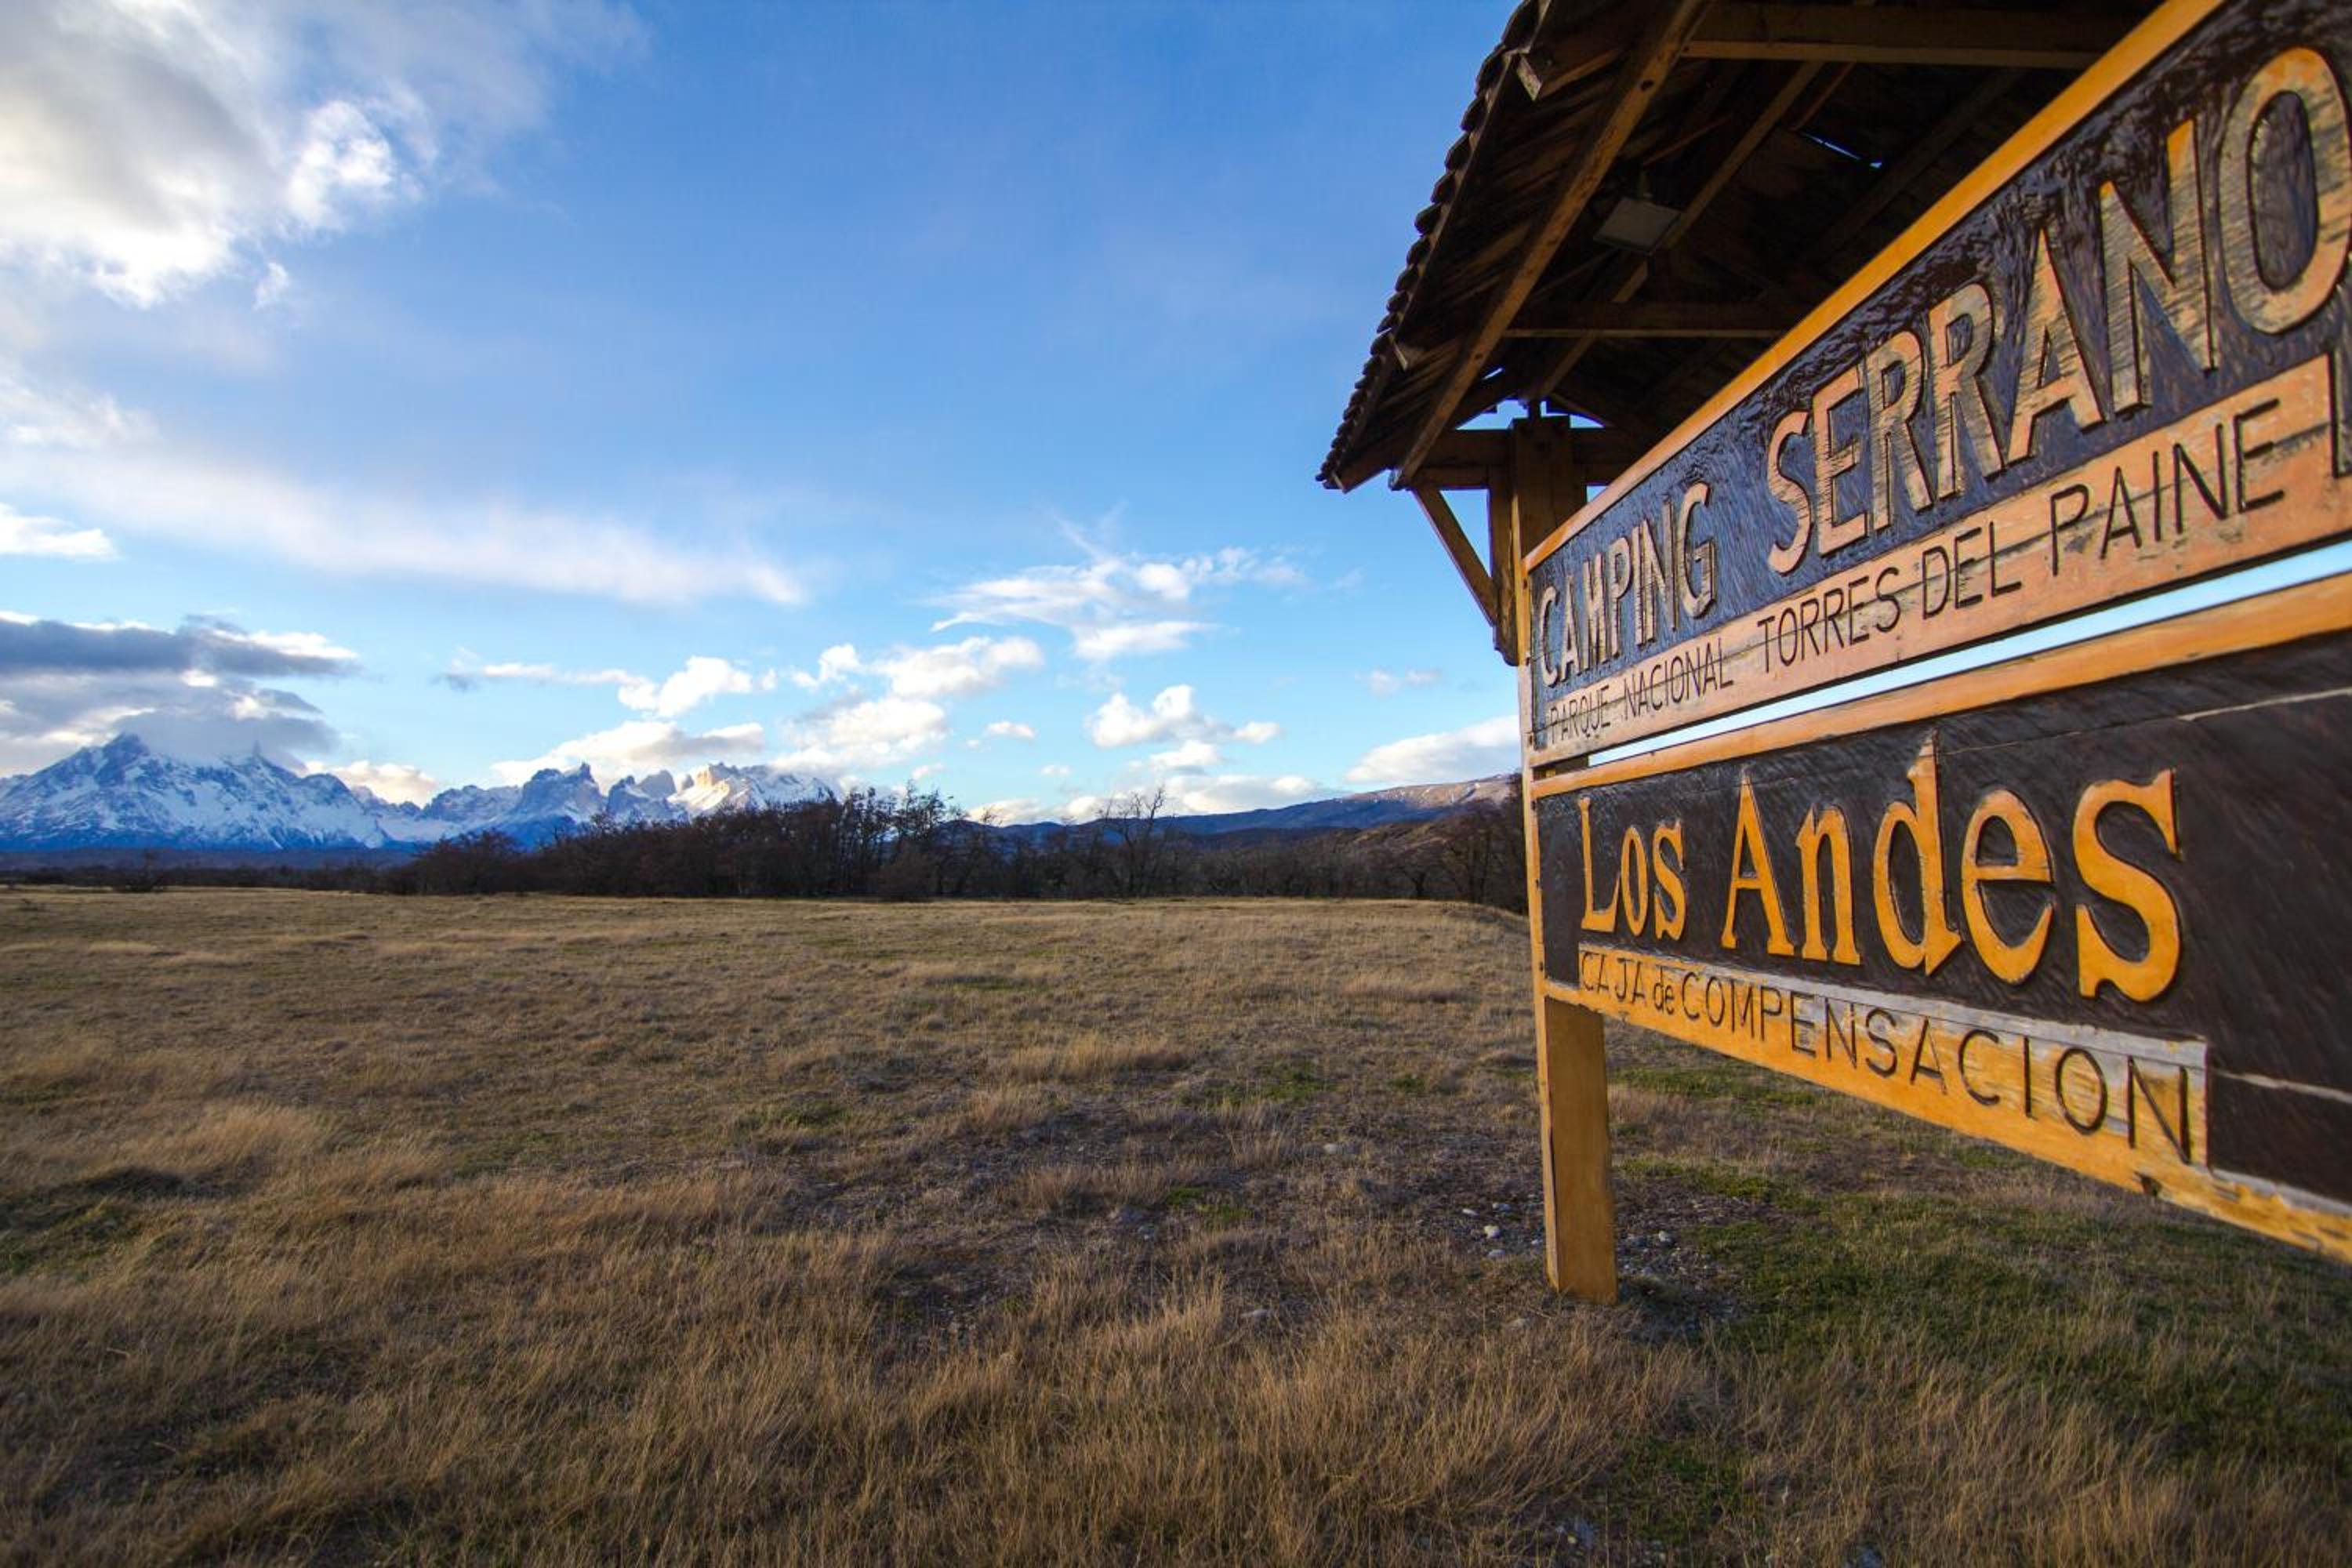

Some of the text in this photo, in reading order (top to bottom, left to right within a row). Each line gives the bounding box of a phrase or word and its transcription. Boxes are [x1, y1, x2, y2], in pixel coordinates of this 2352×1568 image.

[1539, 46, 2352, 688] CAMPING SERRANO
[1549, 398, 2285, 744] PARQUE NACIONAL TORRES DEL PAINE
[1579, 731, 2183, 1003] Los Andes
[1581, 950, 2191, 1164] CAJA de COMPENSACION
